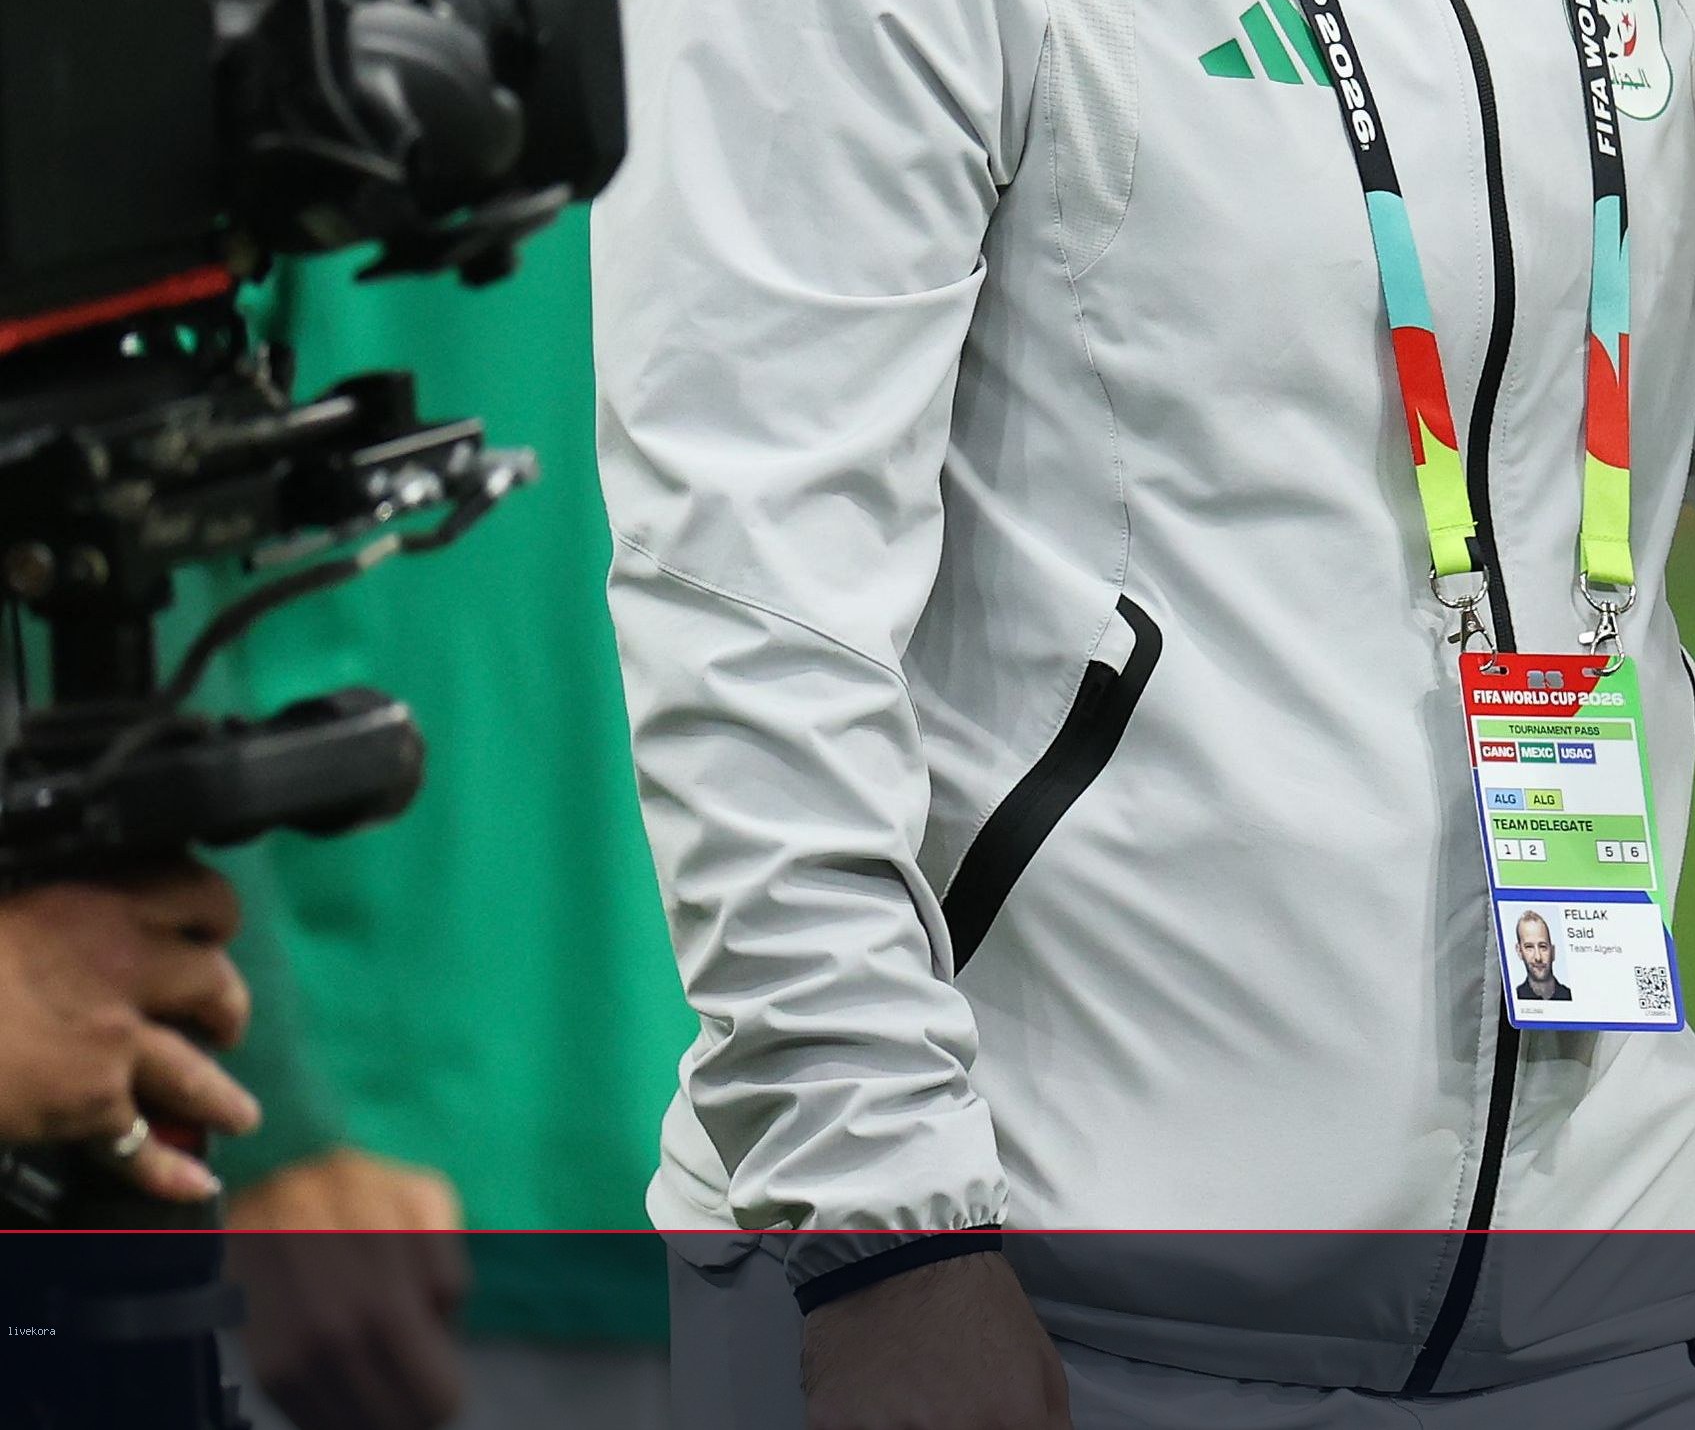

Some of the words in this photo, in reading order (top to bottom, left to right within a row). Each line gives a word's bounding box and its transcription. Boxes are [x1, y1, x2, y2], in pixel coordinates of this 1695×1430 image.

[1314, 12, 1376, 146] 2026
[1590, 77, 1617, 157] FIFA
[1473, 690, 1502, 705] FIFA
[1502, 690, 1549, 706] WORLD
[1550, 691, 1577, 706] CUP
[1577, 691, 1626, 707] 2026
[1508, 724, 1573, 736] TOURNAMENT
[1574, 726, 1601, 737] PASS
[1481, 745, 1515, 758] CANC
[1520, 746, 1554, 759] MEXC
[1560, 747, 1593, 760] USAC
[1494, 794, 1517, 805] ALG
[1532, 794, 1556, 806] ALG
[1492, 818, 1528, 832] TEAM
[1530, 819, 1594, 833] DELEGATE
[1504, 843, 1512, 856] 1
[1528, 844, 1538, 856] 2
[1604, 846, 1614, 858] 5
[1630, 846, 1640, 858] 6
[1564, 908, 1608, 921] FELLAK
[1569, 944, 1593, 953] Team
[1594, 944, 1623, 955] Algeria
